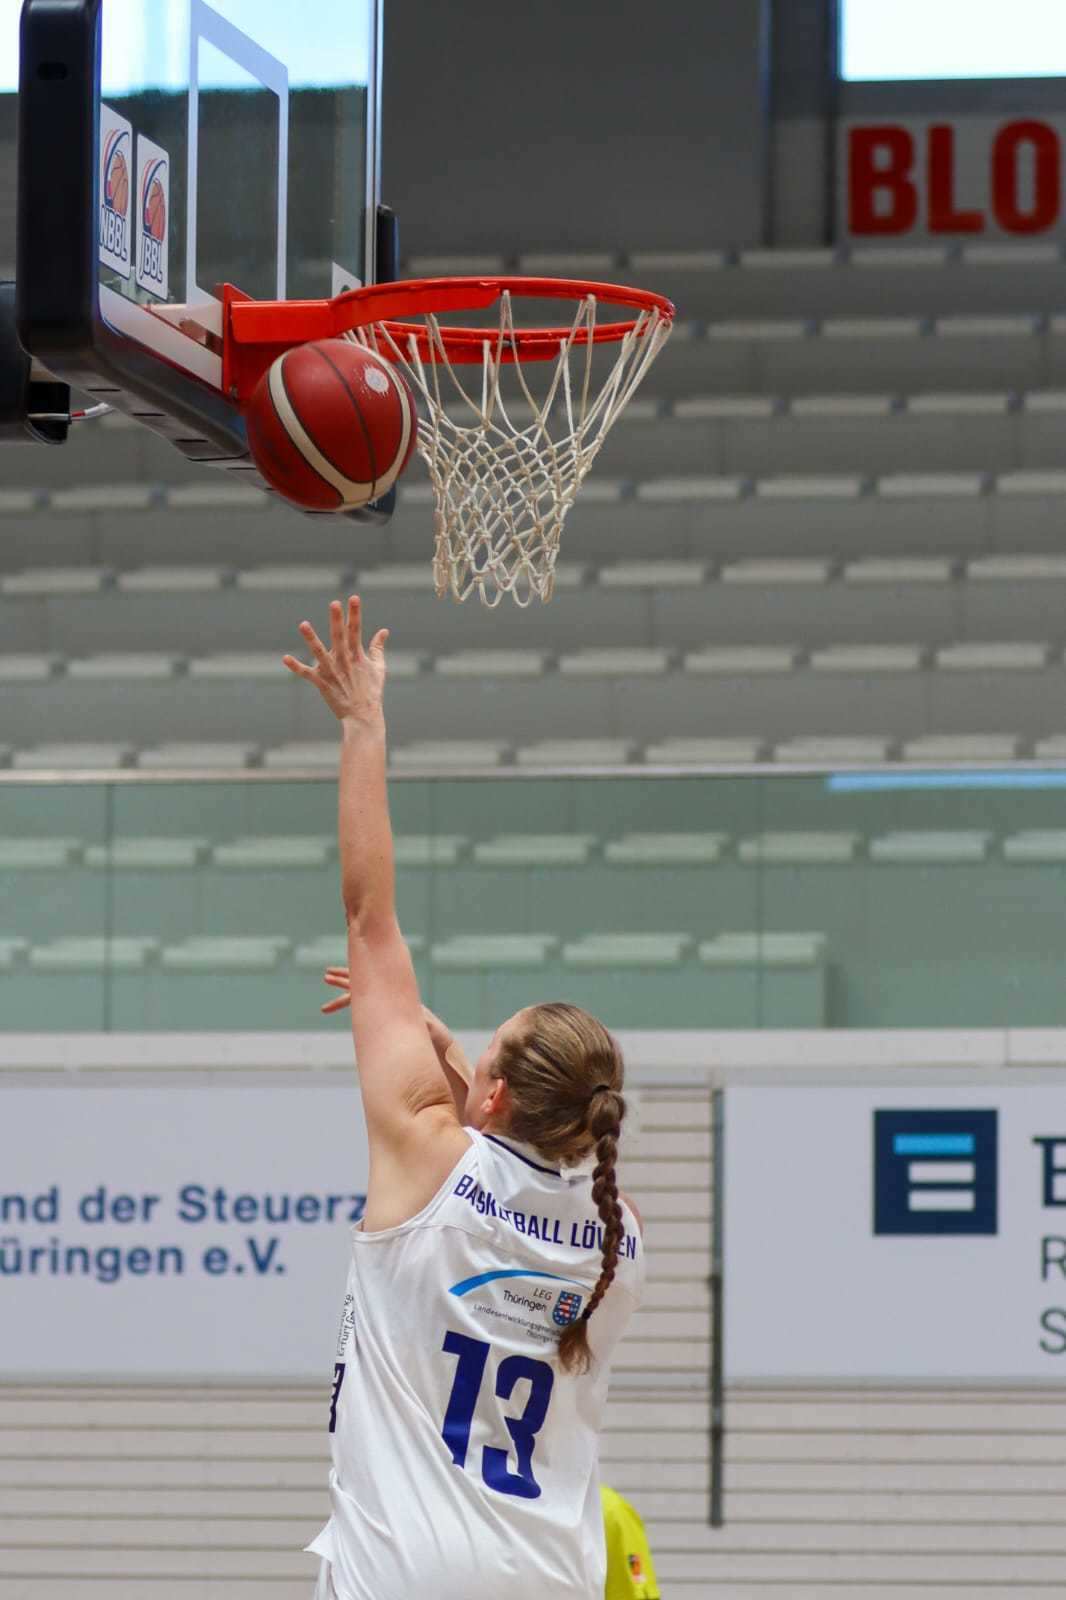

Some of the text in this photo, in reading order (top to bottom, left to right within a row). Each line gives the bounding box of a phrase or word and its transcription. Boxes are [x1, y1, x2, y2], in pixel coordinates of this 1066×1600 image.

[848, 118, 1061, 236] BLO
[100, 204, 128, 262] NBBL
[140, 232, 163, 283] JBBL
[1, 1185, 58, 1223] nd
[78, 1186, 161, 1223] der
[0, 1237, 285, 1283] üringen e.V.
[503, 1289, 547, 1312] Thüringen
[533, 1288, 553, 1300] LEG
[441, 1330, 554, 1499] 13
